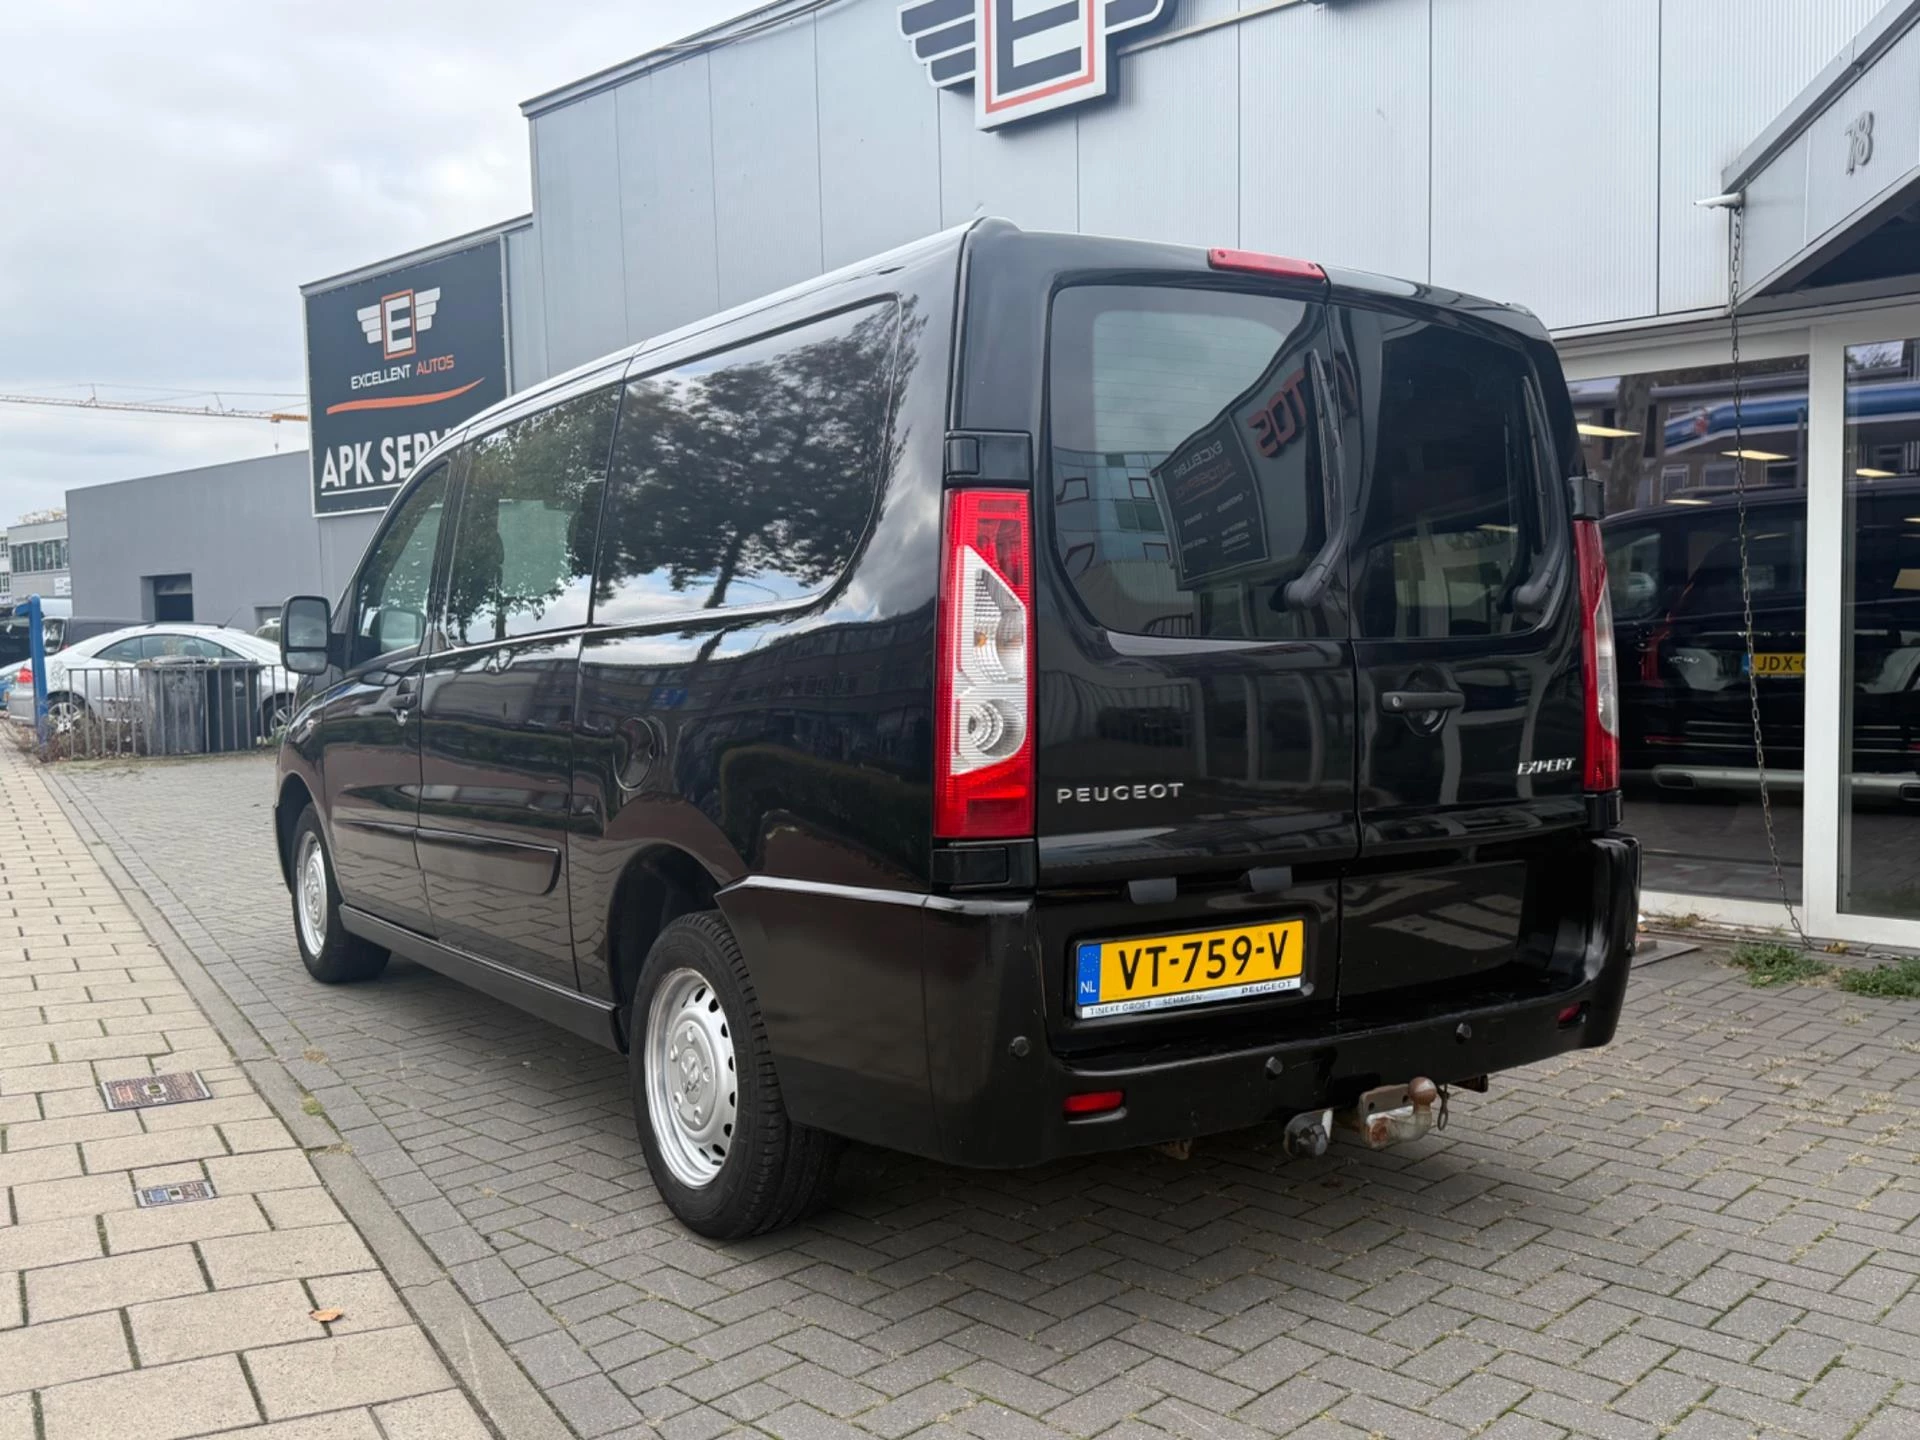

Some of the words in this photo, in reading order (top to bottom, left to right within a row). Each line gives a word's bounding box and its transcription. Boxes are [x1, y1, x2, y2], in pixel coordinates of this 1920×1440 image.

[351, 364, 412, 390] EXCELLENT
[416, 355, 455, 377] AUTOS
[321, 441, 375, 489] APK
[1517, 757, 1576, 775] EXPERT
[1057, 782, 1184, 804] PEUGEOT
[1118, 930, 1289, 990] VT-759-V
[1080, 980, 1097, 995] NL
[1241, 980, 1292, 994] PEUGEOT
